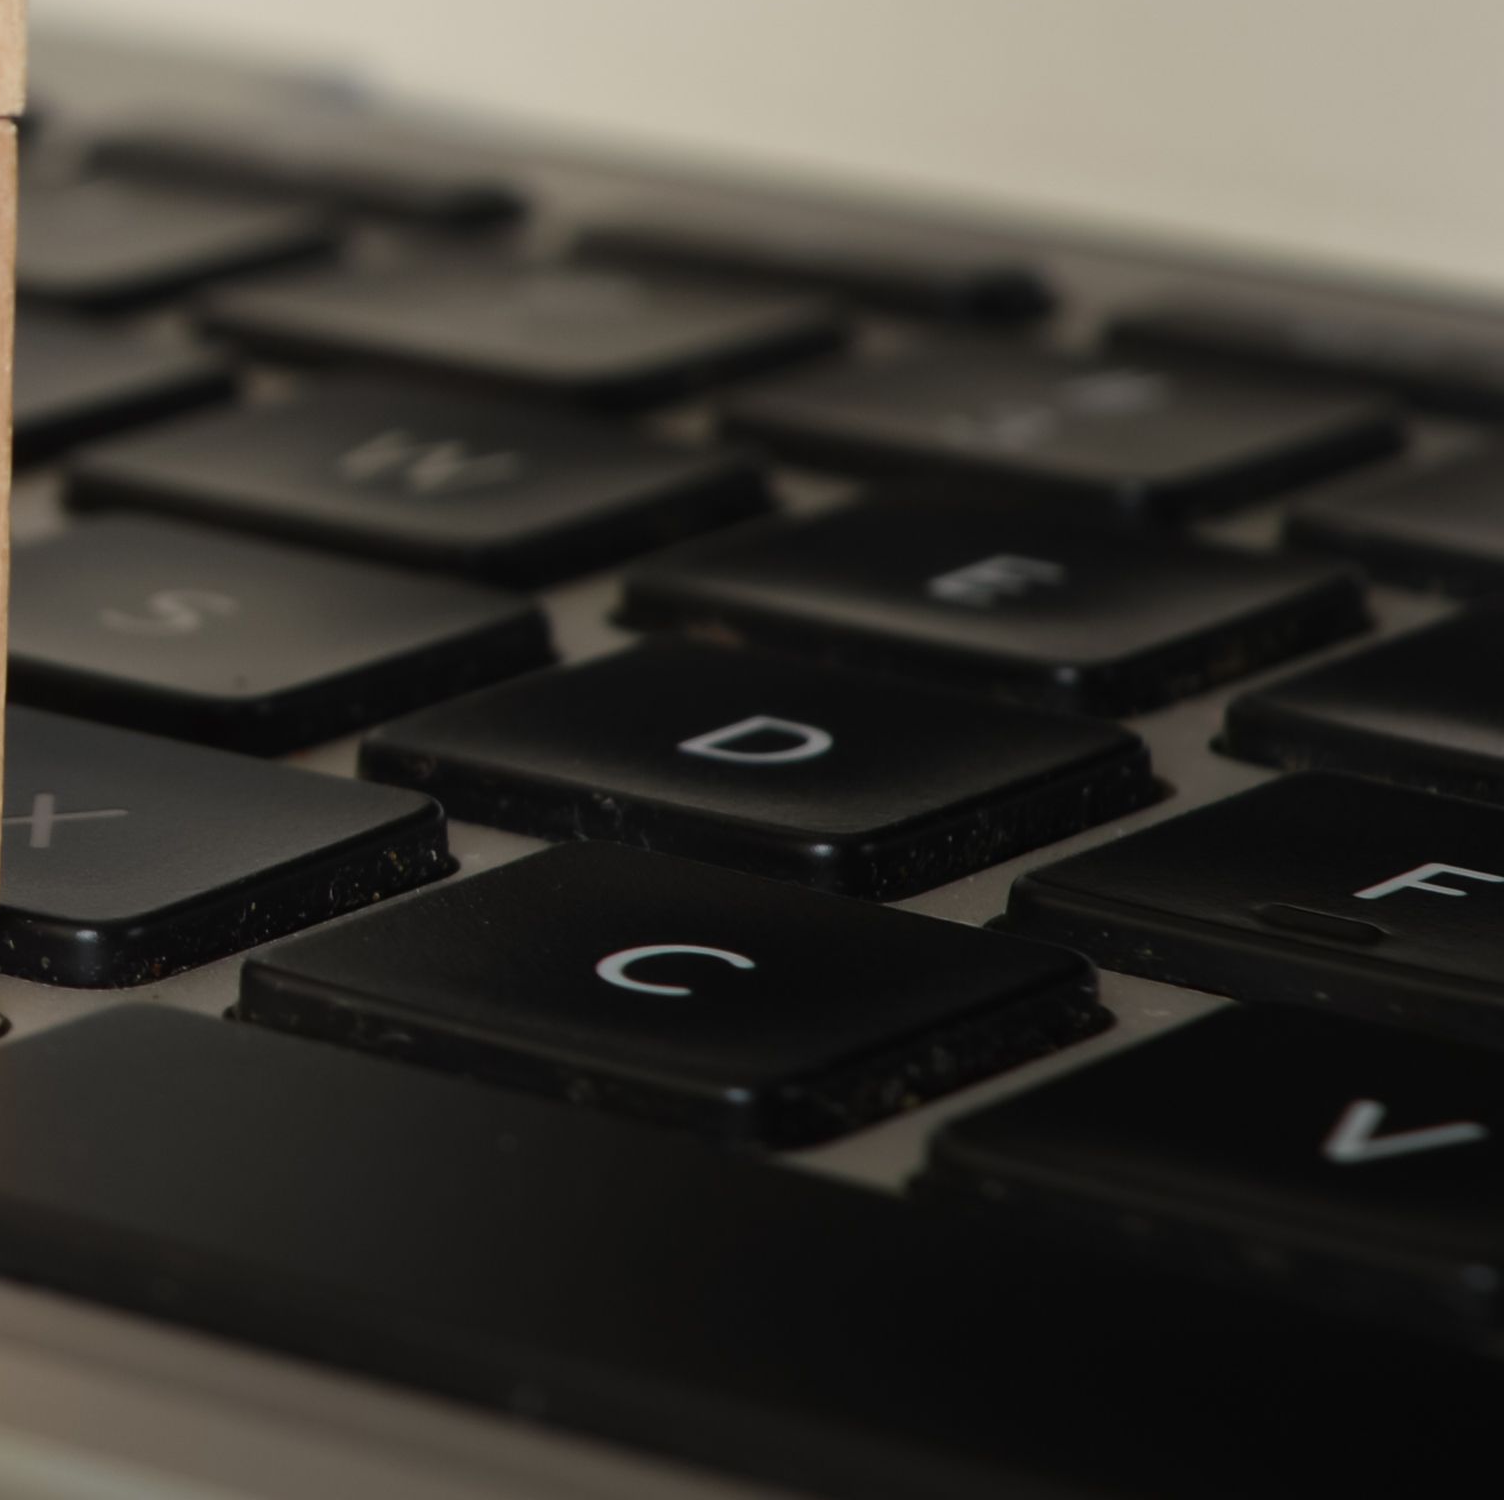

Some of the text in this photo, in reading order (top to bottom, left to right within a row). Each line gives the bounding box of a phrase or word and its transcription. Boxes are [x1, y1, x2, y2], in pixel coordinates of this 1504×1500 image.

[335, 430, 520, 496] W
[925, 551, 1067, 609] E
[98, 586, 235, 636] S
[676, 714, 834, 767] D
[1352, 861, 1504, 900] F
[594, 942, 756, 998] C
[1322, 1098, 1490, 1165] V
